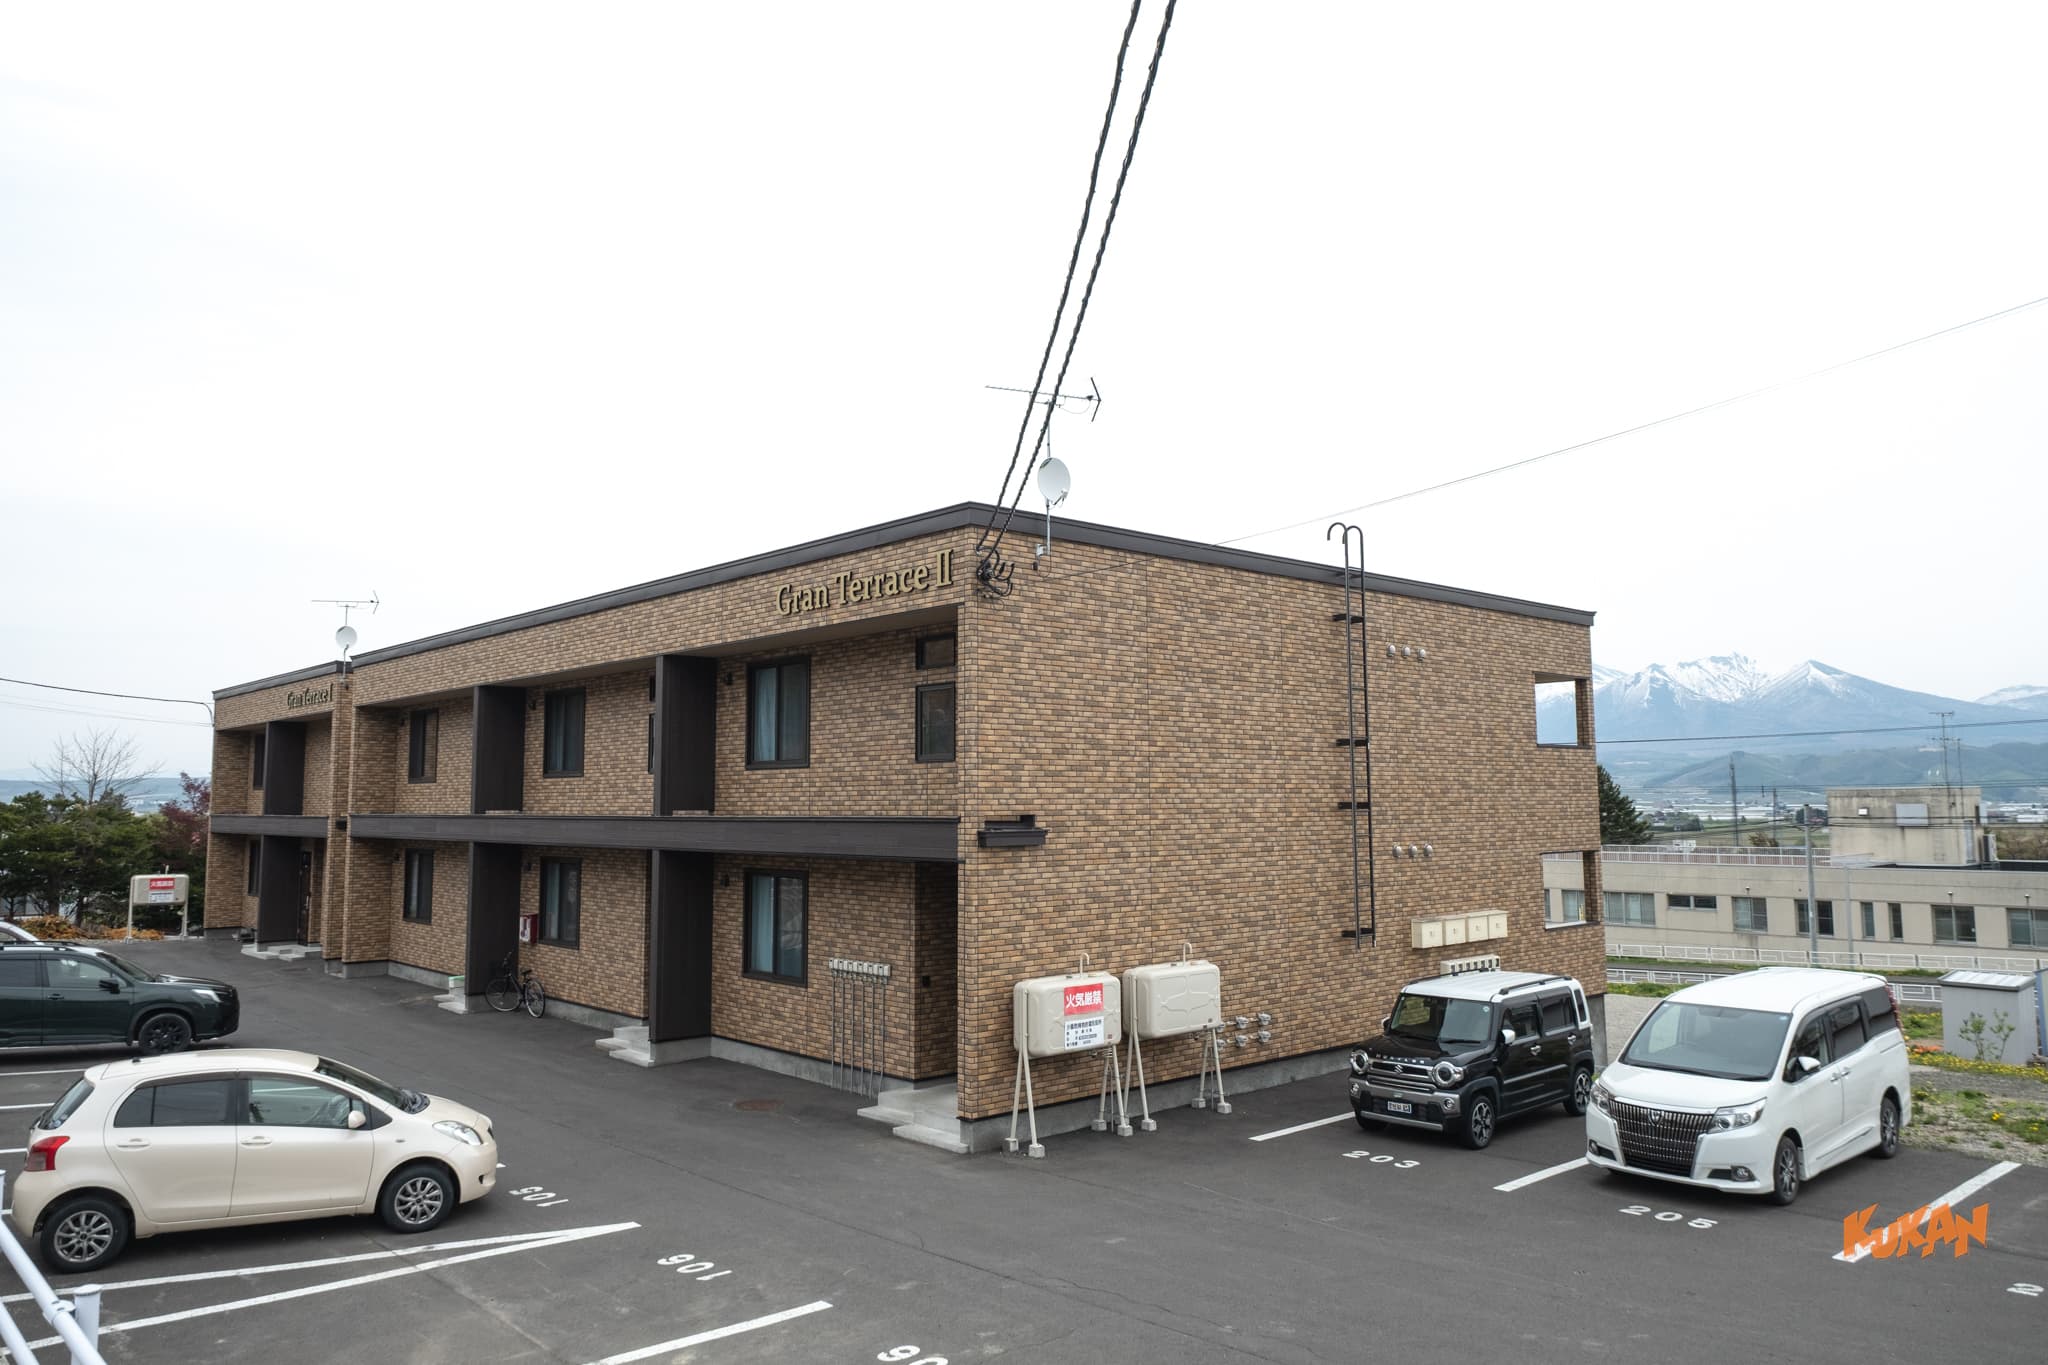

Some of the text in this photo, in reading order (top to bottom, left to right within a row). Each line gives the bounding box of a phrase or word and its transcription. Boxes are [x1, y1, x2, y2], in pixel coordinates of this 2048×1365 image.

[776, 583, 829, 616] Gran
[835, 570, 930, 606] Terrace
[1066, 990, 1103, 1009] 火気厳禁
[1341, 1150, 1421, 1169] 203
[1618, 1205, 1719, 1229] 205
